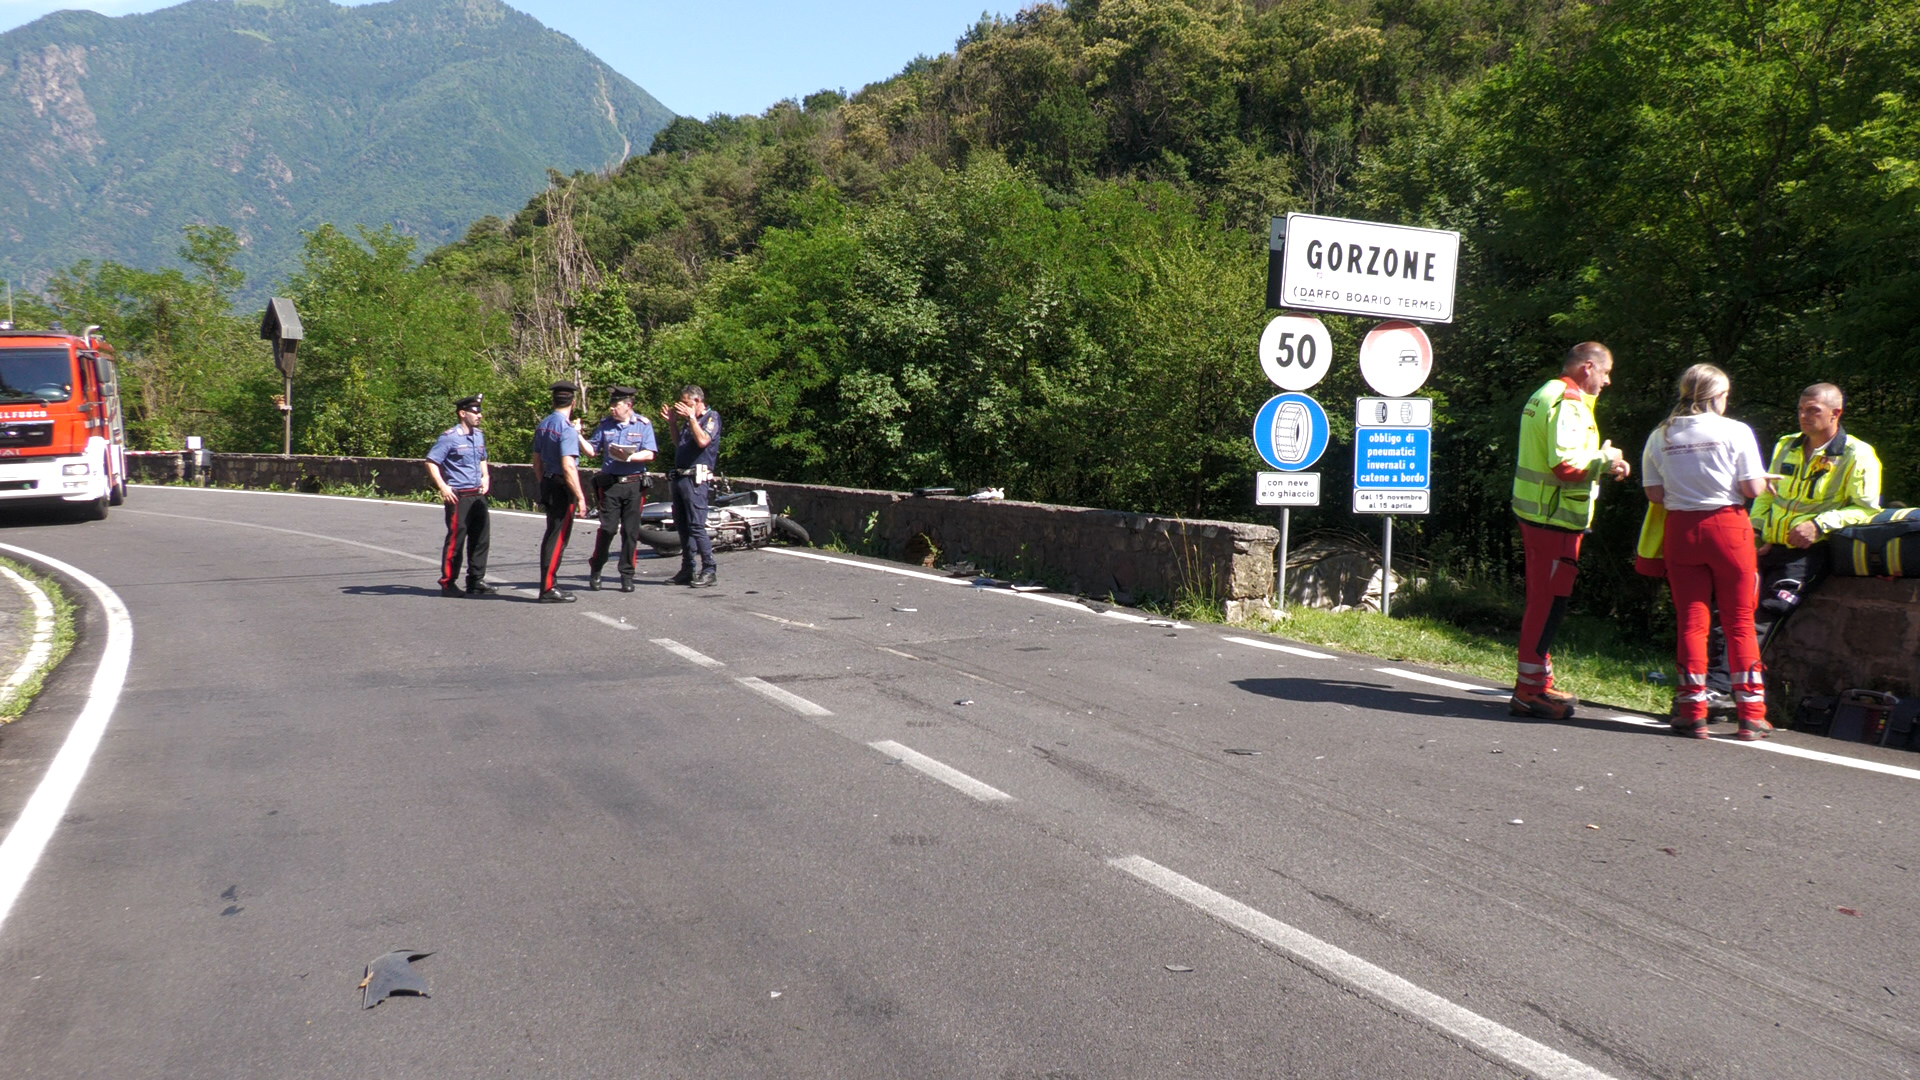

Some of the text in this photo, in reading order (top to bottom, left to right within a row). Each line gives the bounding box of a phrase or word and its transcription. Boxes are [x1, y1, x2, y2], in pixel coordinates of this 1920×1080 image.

[1306, 239, 1436, 282] GORZONE
[1293, 286, 1442, 312] (DARFO BOARIO TERME)
[1275, 332, 1317, 370] 50
[1369, 433, 1415, 445] obbligo di
[1367, 446, 1416, 458] pneumatici
[1366, 459, 1416, 470] invernali o
[1360, 472, 1390, 482] catene
[1400, 472, 1425, 482] bordo
[1278, 489, 1315, 499] ghiaccio
[1391, 502, 1413, 510] aprile
